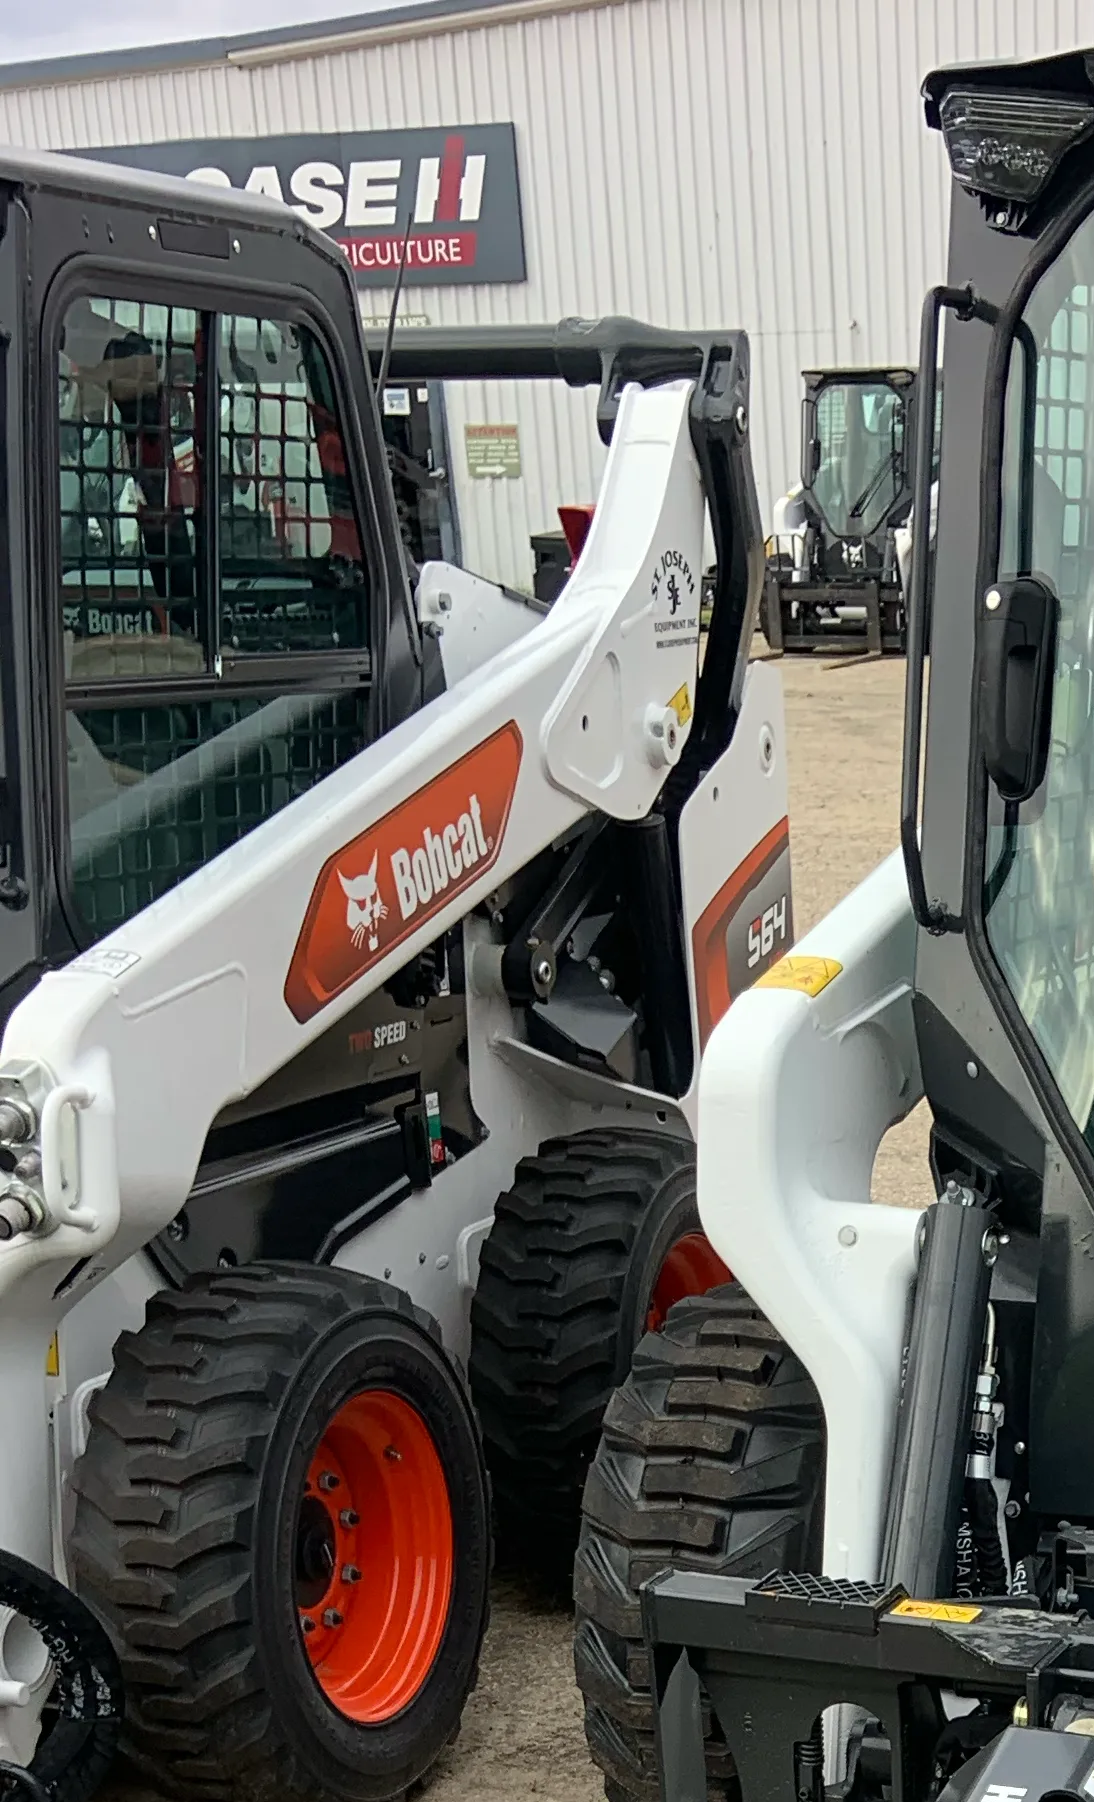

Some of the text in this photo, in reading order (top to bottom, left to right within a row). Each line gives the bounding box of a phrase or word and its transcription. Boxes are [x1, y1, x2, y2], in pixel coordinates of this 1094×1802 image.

[390, 793, 488, 920] Bobcat
[747, 894, 786, 969] S64
[349, 1020, 407, 1053] TWO SPEED
